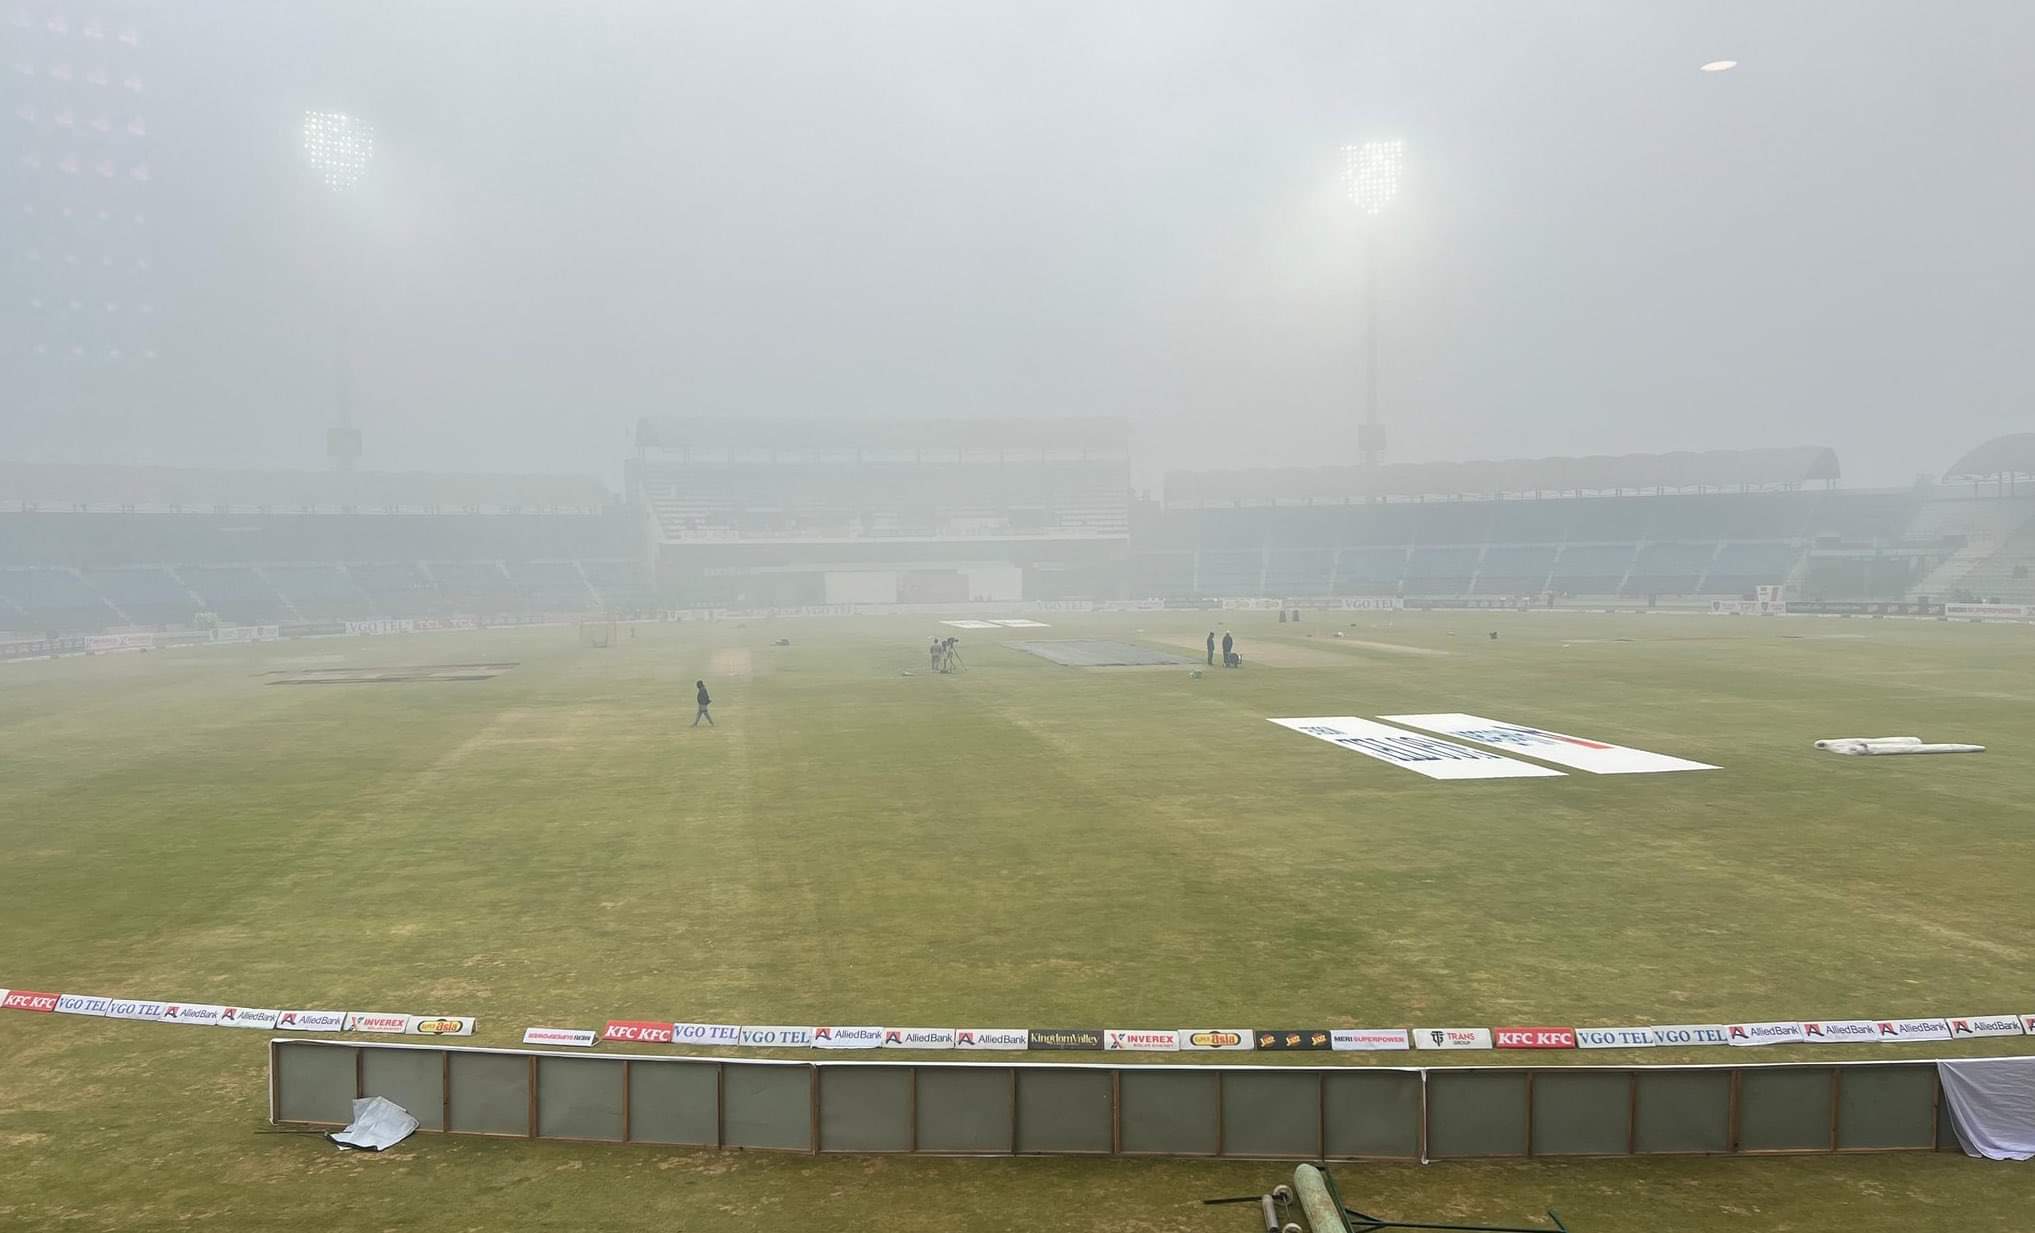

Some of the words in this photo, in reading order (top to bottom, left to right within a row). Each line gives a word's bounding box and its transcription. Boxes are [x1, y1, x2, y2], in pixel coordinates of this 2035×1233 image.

[5, 994, 32, 1007] KFC
[31, 996, 56, 1009] KFC
[58, 998, 83, 1010] VGO
[84, 999, 107, 1012] TEL
[111, 1003, 136, 1014] VGO
[138, 1004, 161, 1016] TEL
[363, 1018, 405, 1027] INVEREX
[605, 1025, 637, 1038] KFC
[638, 1028, 670, 1041] KFC
[674, 1026, 706, 1038] VGO
[710, 1027, 738, 1039] TEL
[742, 1030, 775, 1043] VGO
[780, 1031, 810, 1043] TEL
[1128, 1035, 1174, 1043] INVEREX
[1447, 1032, 1476, 1041] TRANS
[1498, 1032, 1534, 1045] KFC
[1536, 1032, 1572, 1045] KFC
[1578, 1033, 1616, 1044] VGO
[1618, 1032, 1655, 1044] TEL
[1655, 1031, 1691, 1042] VGO
[1693, 1030, 1728, 1041] TEL
